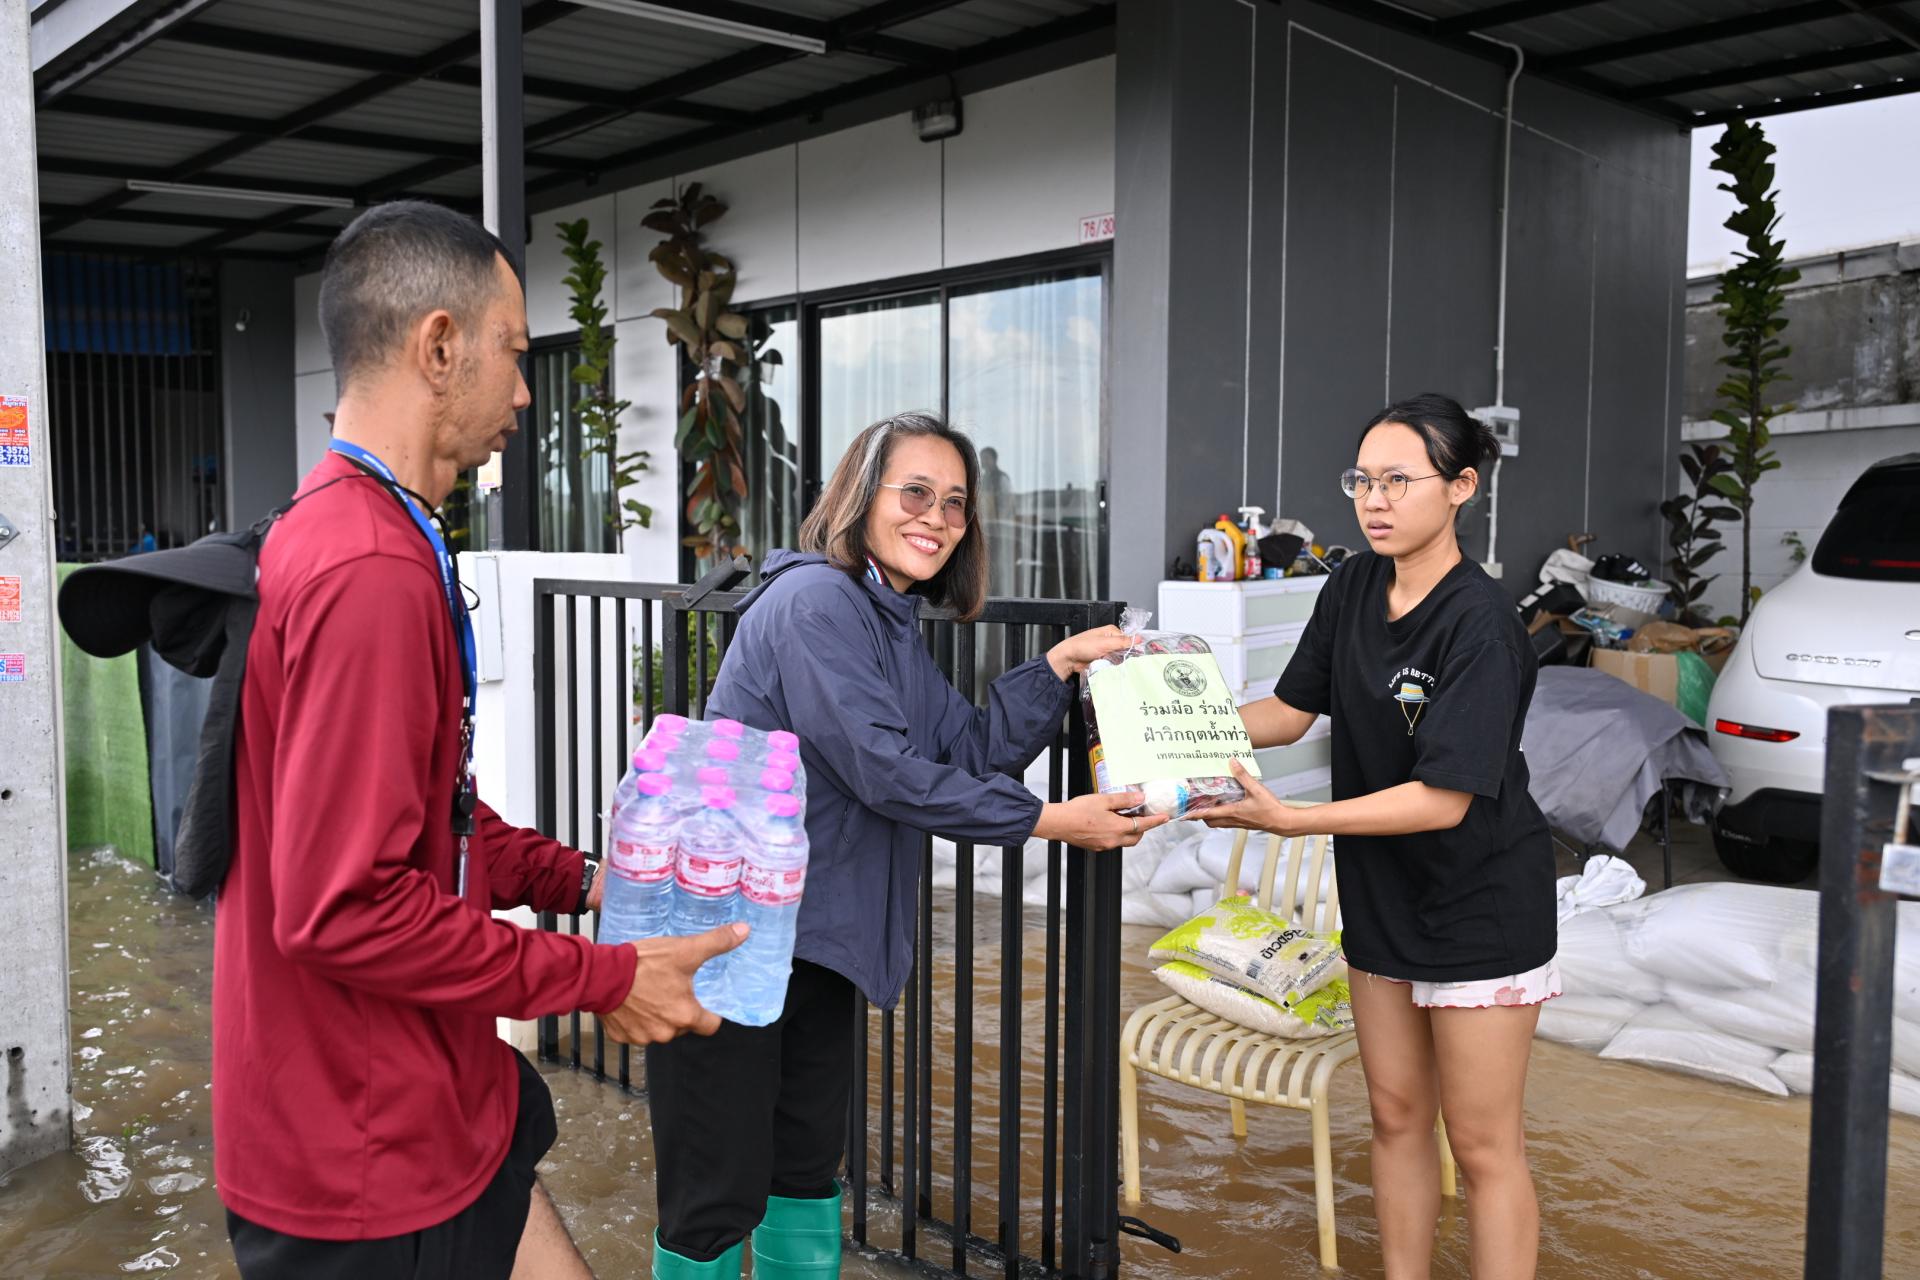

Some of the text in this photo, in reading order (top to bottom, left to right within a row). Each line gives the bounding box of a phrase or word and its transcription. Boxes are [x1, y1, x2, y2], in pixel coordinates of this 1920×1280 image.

[1139, 698, 1239, 717] ร่วมมือ ร่วมใ
